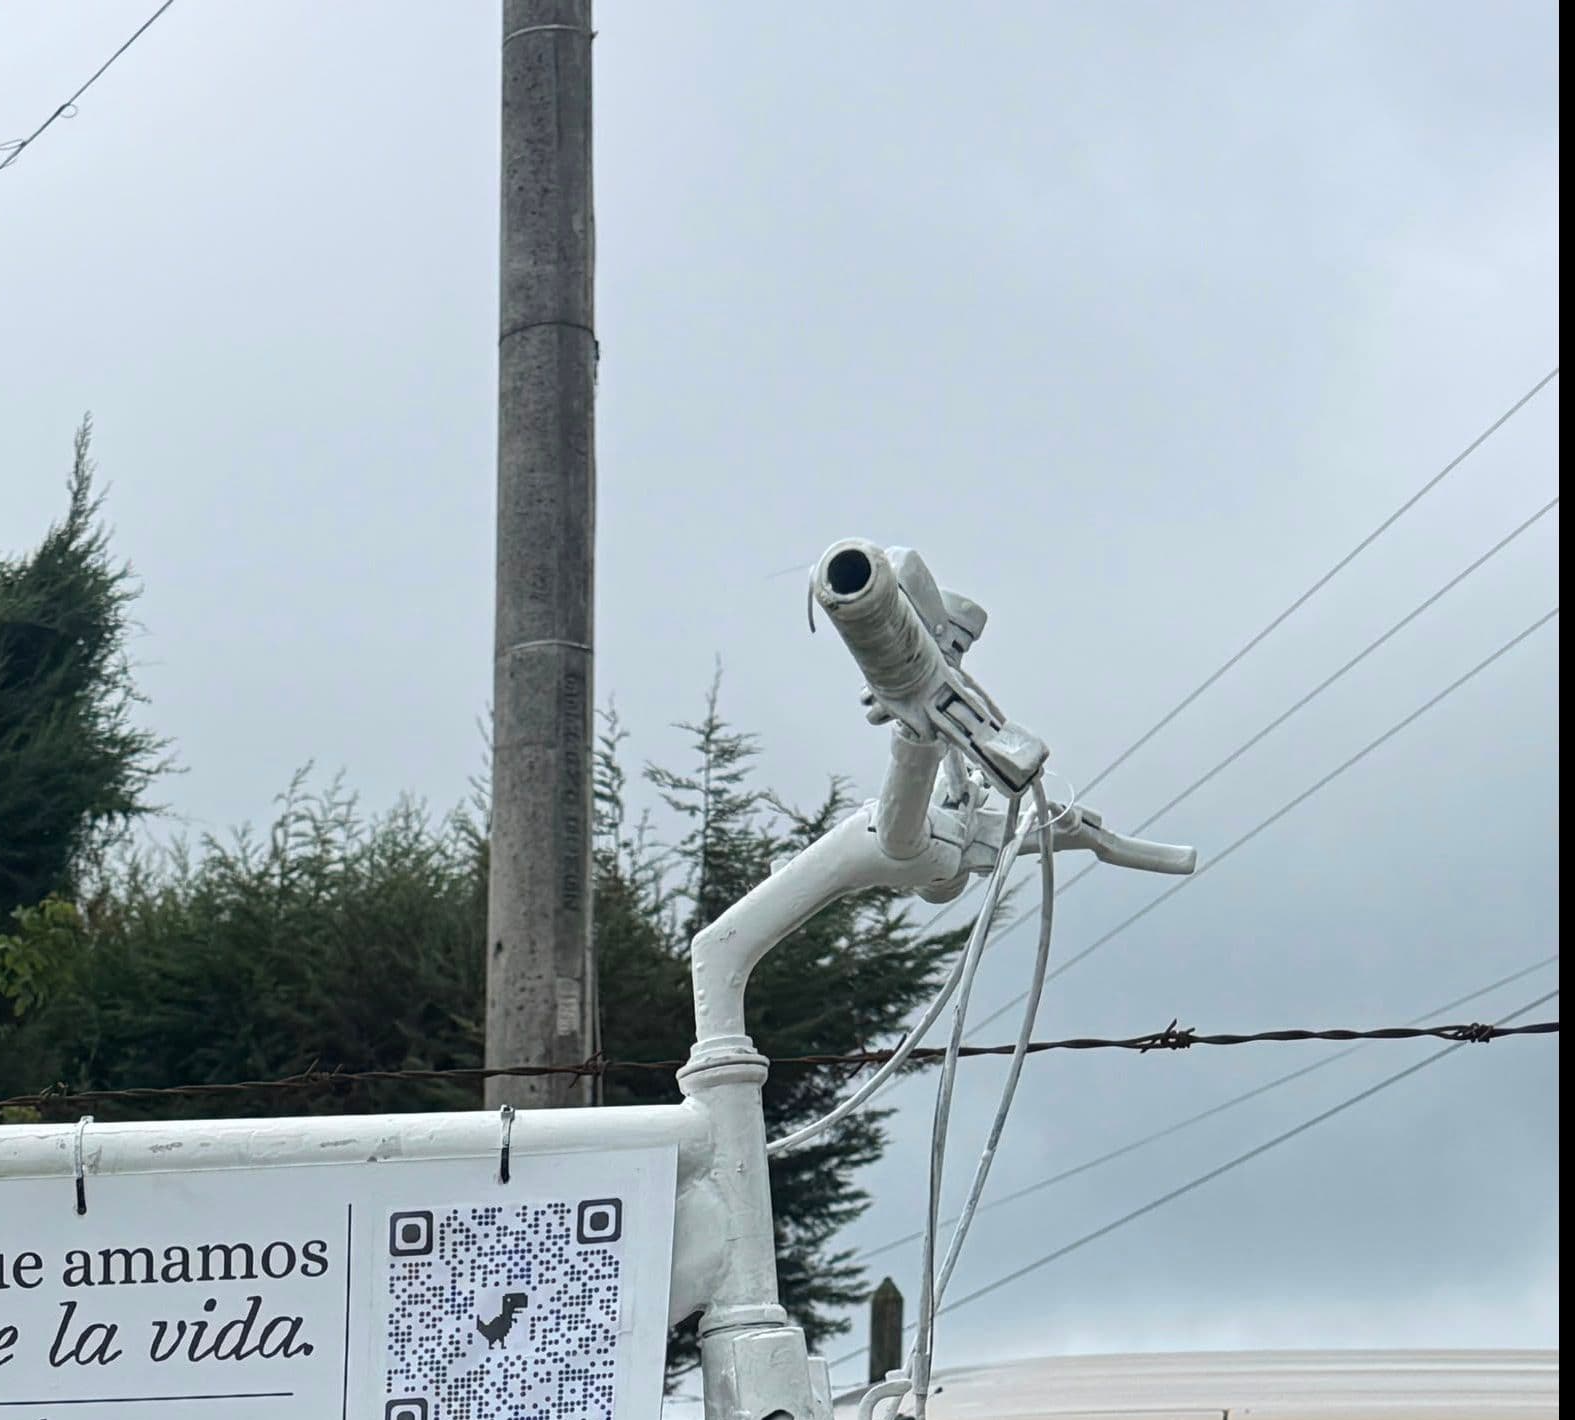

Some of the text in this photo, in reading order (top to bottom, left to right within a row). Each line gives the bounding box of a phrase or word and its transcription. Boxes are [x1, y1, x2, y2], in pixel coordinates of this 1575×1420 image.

[62, 1239, 329, 1287] amamos
[49, 1300, 123, 1367] la
[150, 1295, 314, 1362] vida.
